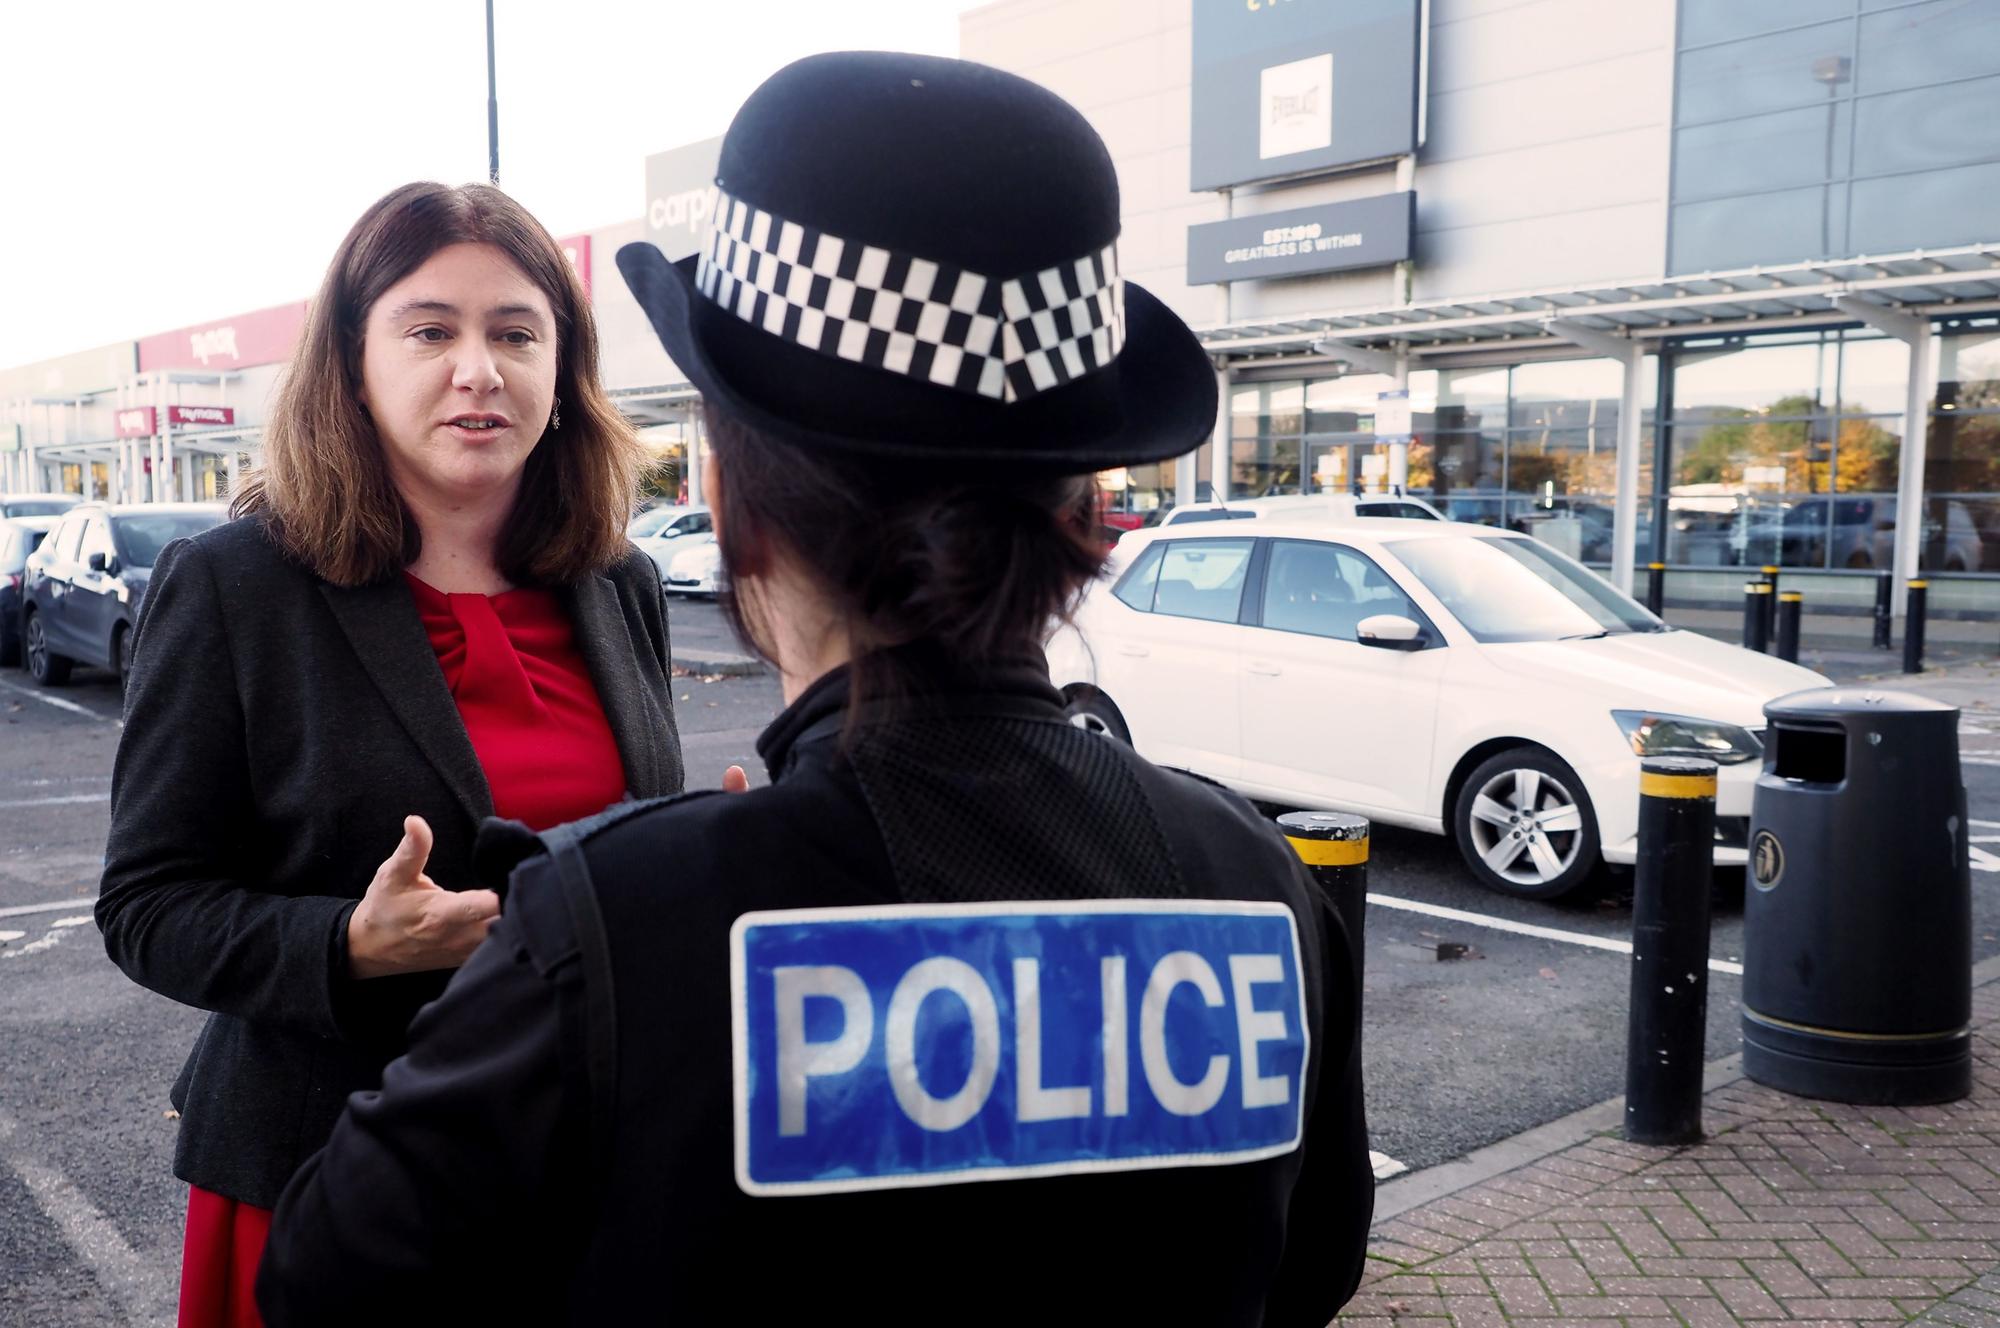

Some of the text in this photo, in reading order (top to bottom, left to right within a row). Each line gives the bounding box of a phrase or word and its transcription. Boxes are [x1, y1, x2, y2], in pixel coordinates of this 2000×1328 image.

[650, 188, 708, 233] carp
[1225, 233, 1362, 264] GREATNESS IS WITHIN
[773, 951, 1290, 1137] POLICE
